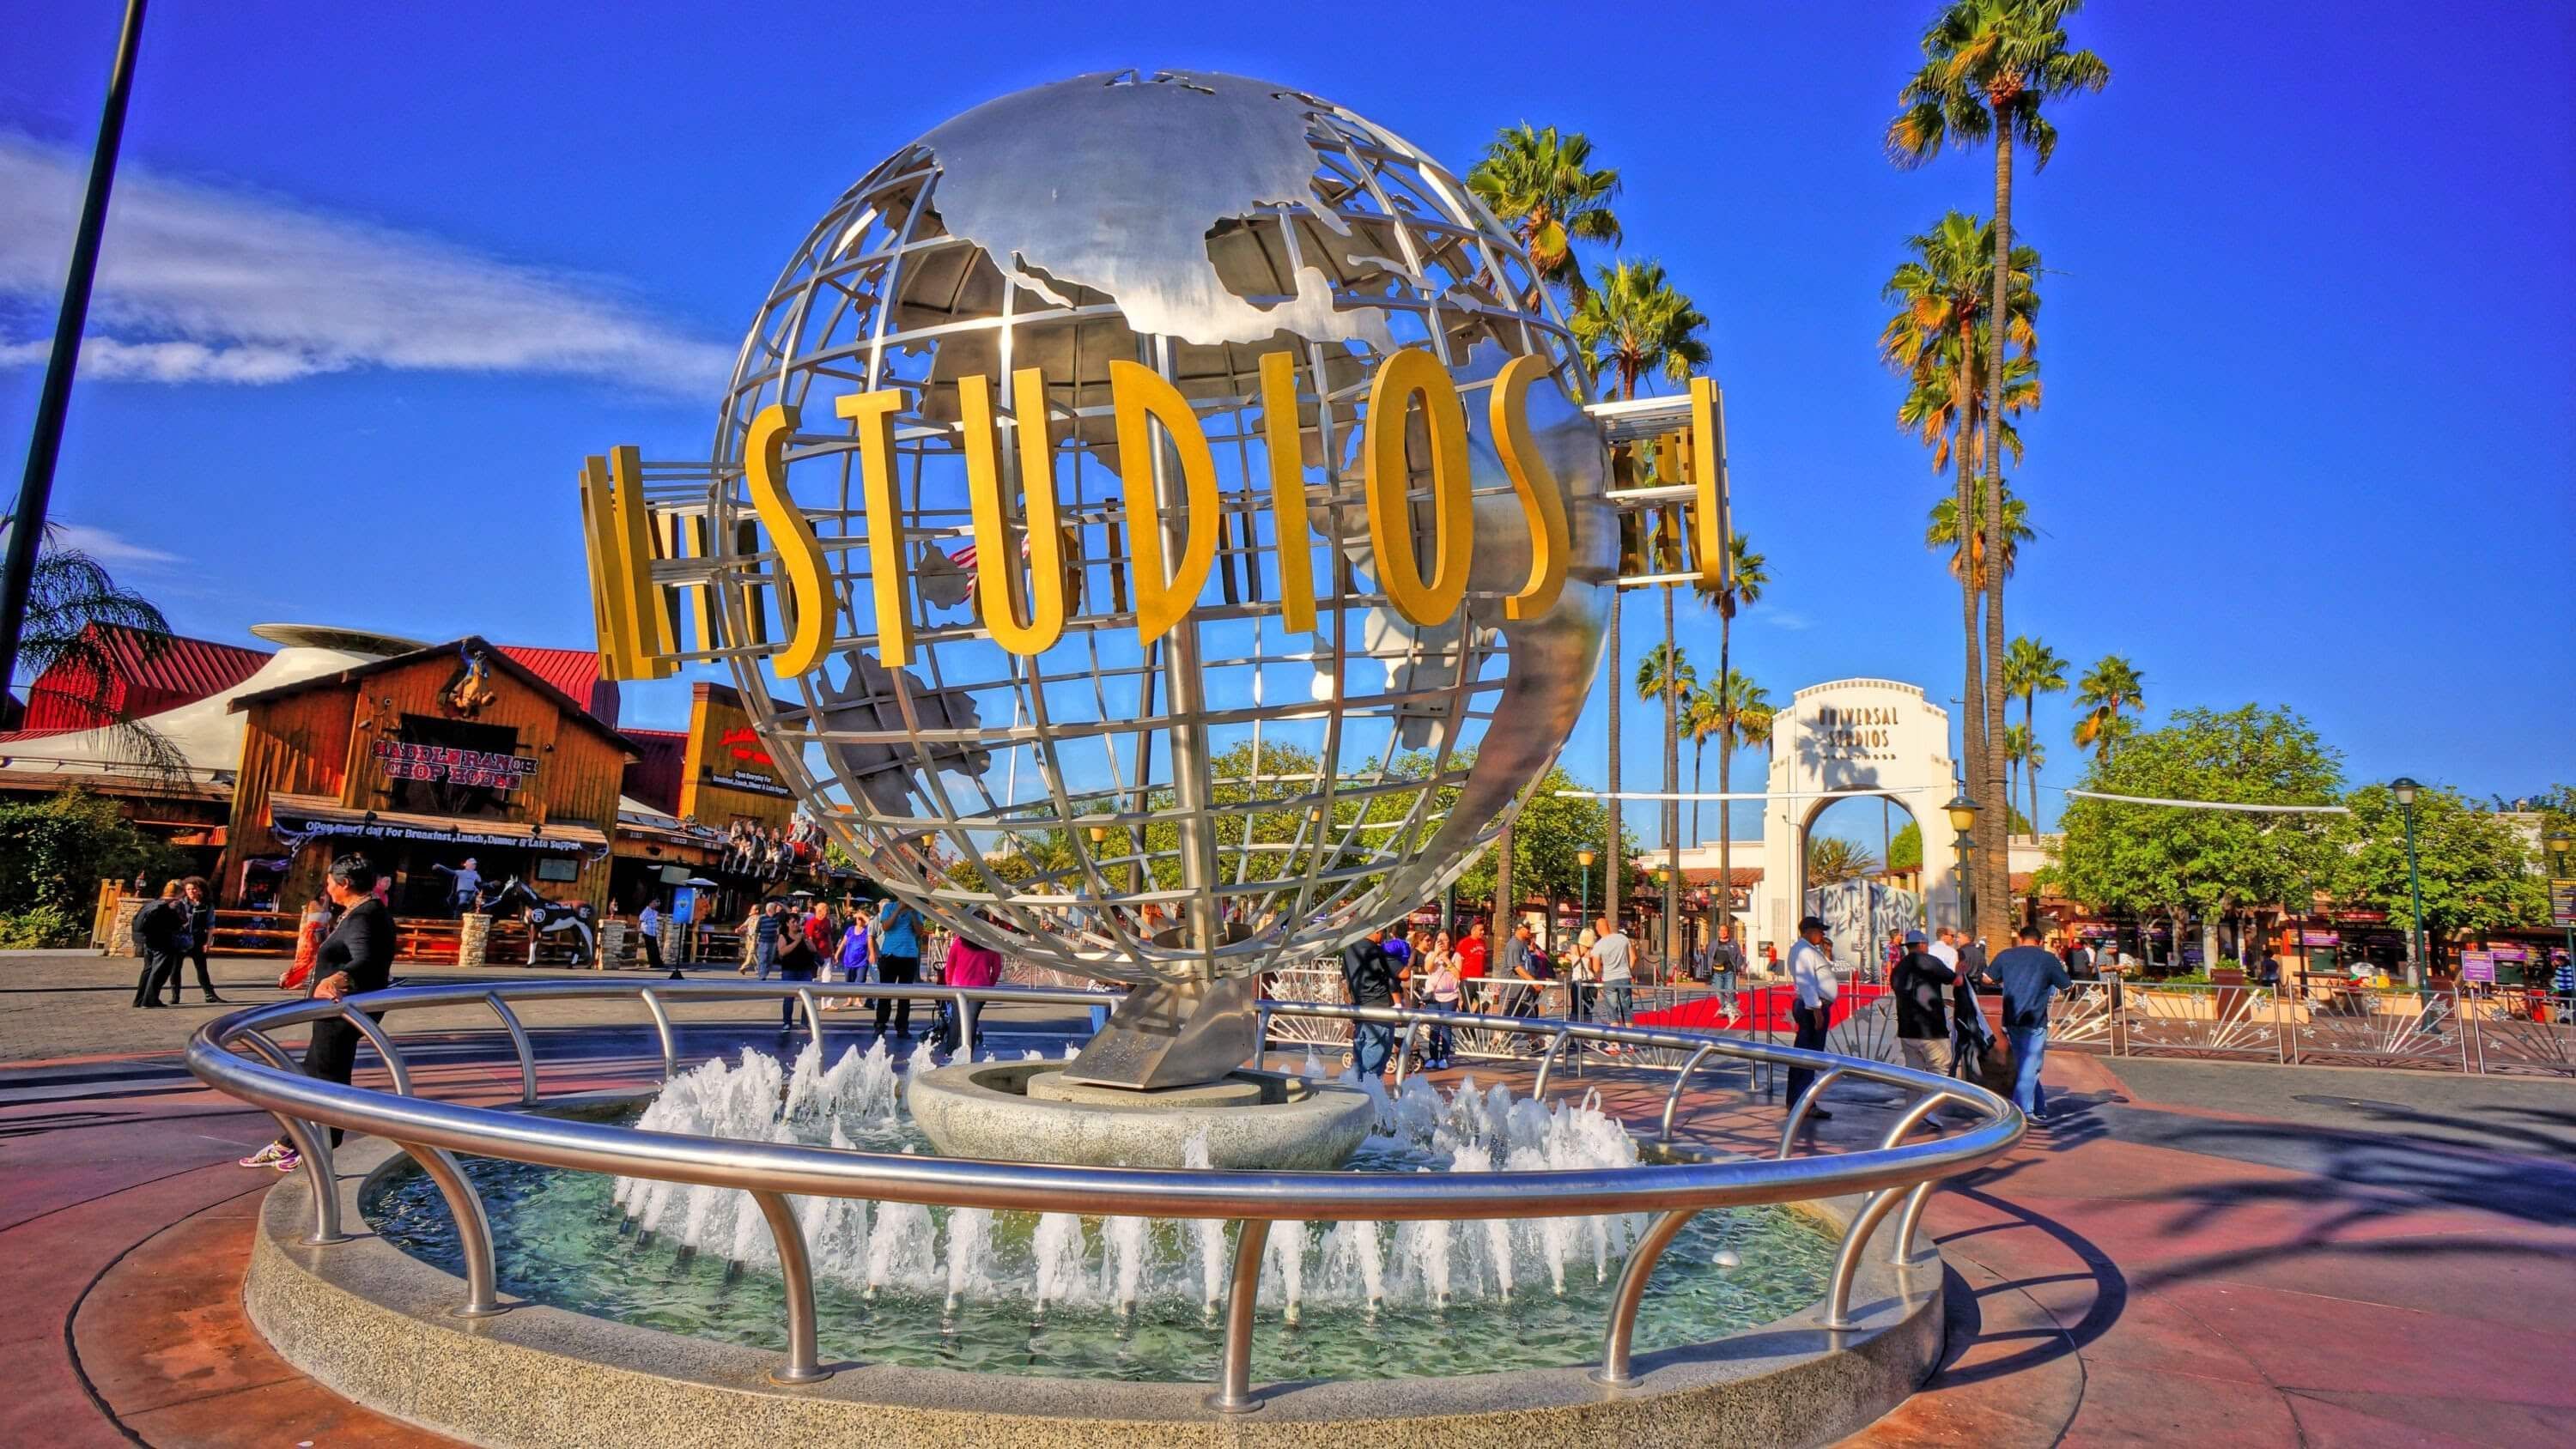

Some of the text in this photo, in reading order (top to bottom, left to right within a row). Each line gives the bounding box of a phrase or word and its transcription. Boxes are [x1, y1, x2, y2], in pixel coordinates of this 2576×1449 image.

[744, 348, 1571, 679] STUDIOS
[1819, 707, 1899, 725] UNIVERSAL
[1828, 729, 1889, 748] STUDIOS
[372, 739, 539, 775] SADDLE RANCH
[384, 760, 522, 790] CHOP HOUSE
[366, 826, 384, 837] day
[386, 828, 405, 837] For
[488, 835, 516, 846] Dinner
[519, 838, 527, 846] &
[527, 838, 549, 848] Late
[550, 840, 582, 851] Supper
[1868, 885, 1914, 914] DEAD
